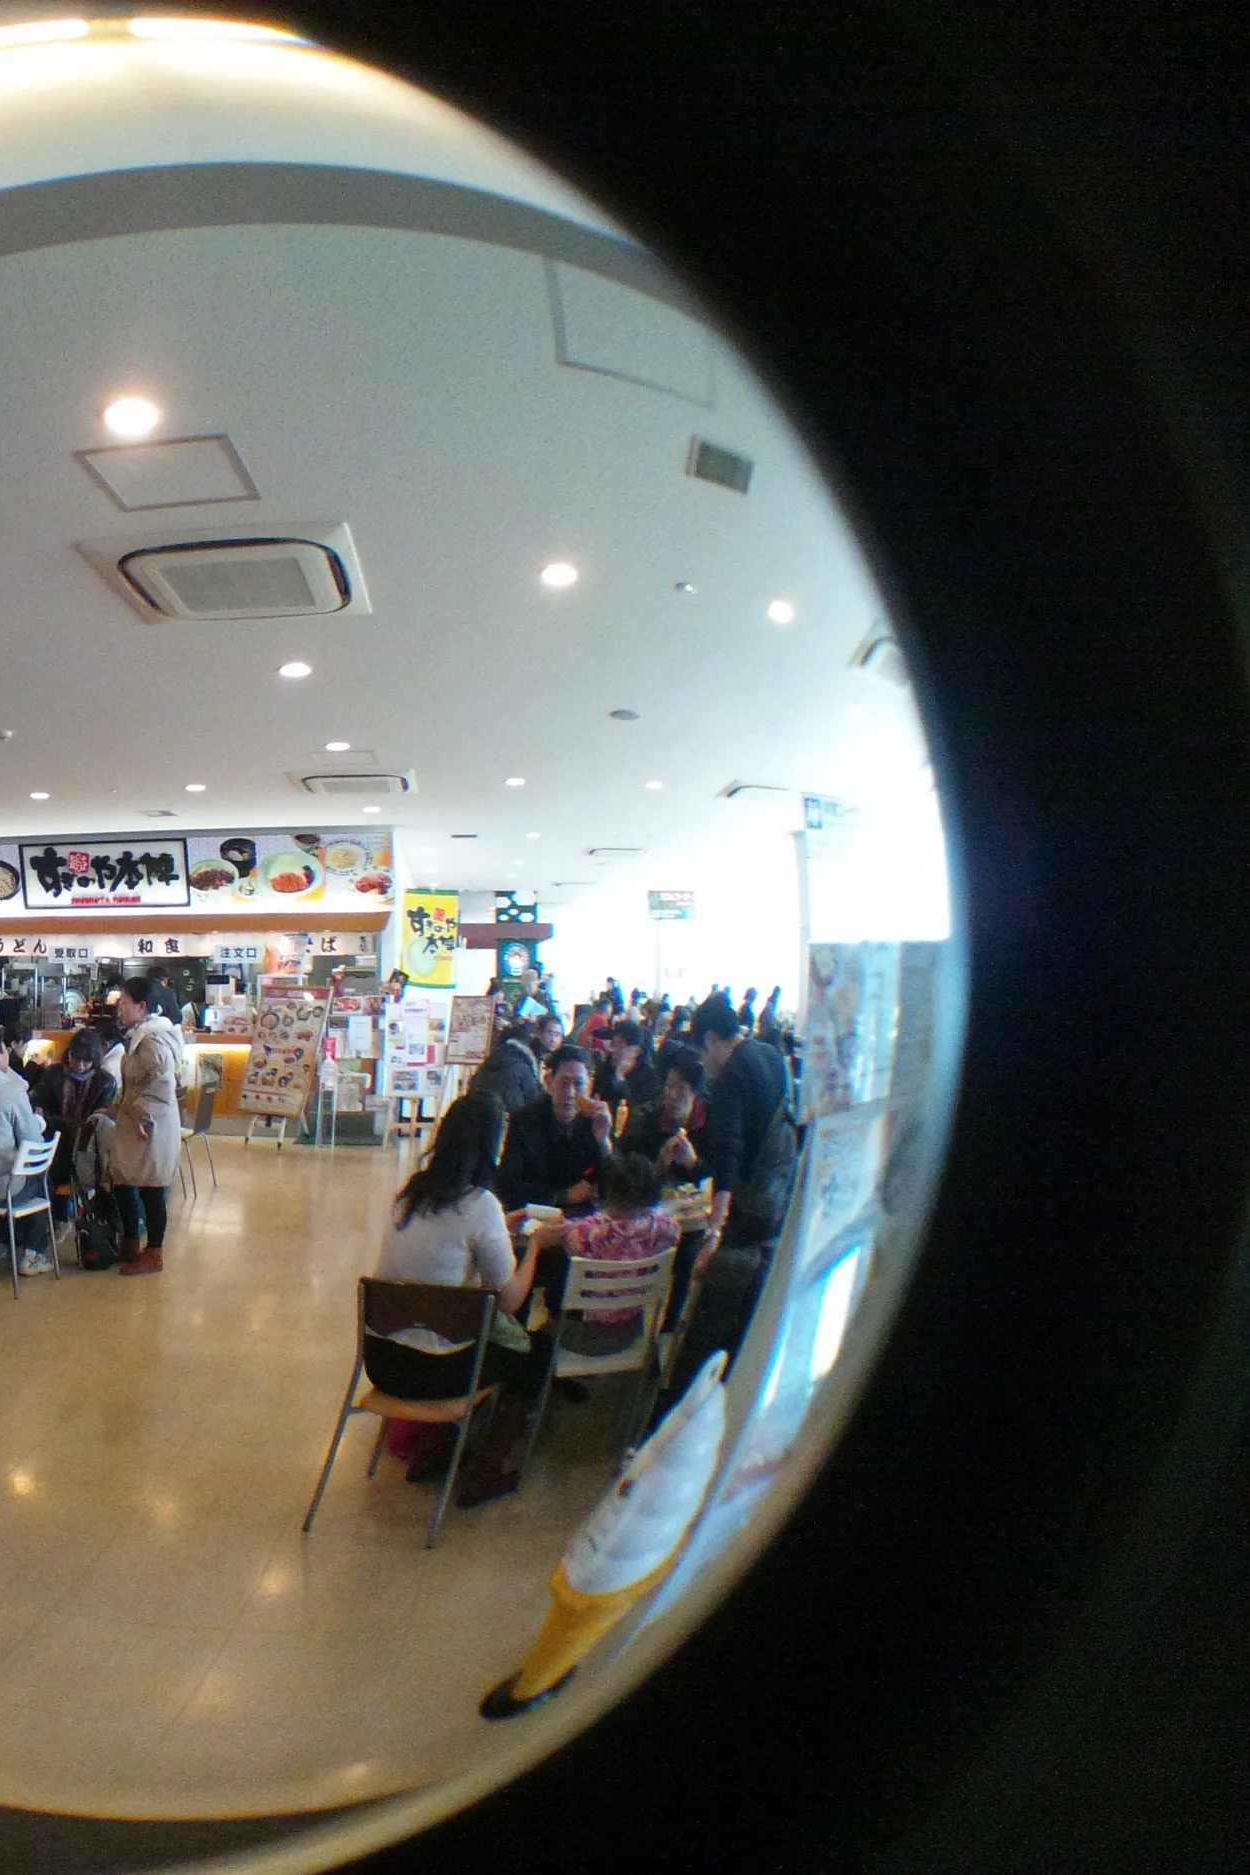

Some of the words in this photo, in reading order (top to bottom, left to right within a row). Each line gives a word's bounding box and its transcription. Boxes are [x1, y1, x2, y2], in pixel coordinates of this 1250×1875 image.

[138, 938, 180, 954] 和食
[54, 948, 88, 958] 受取口
[220, 947, 257, 958] 注文口
